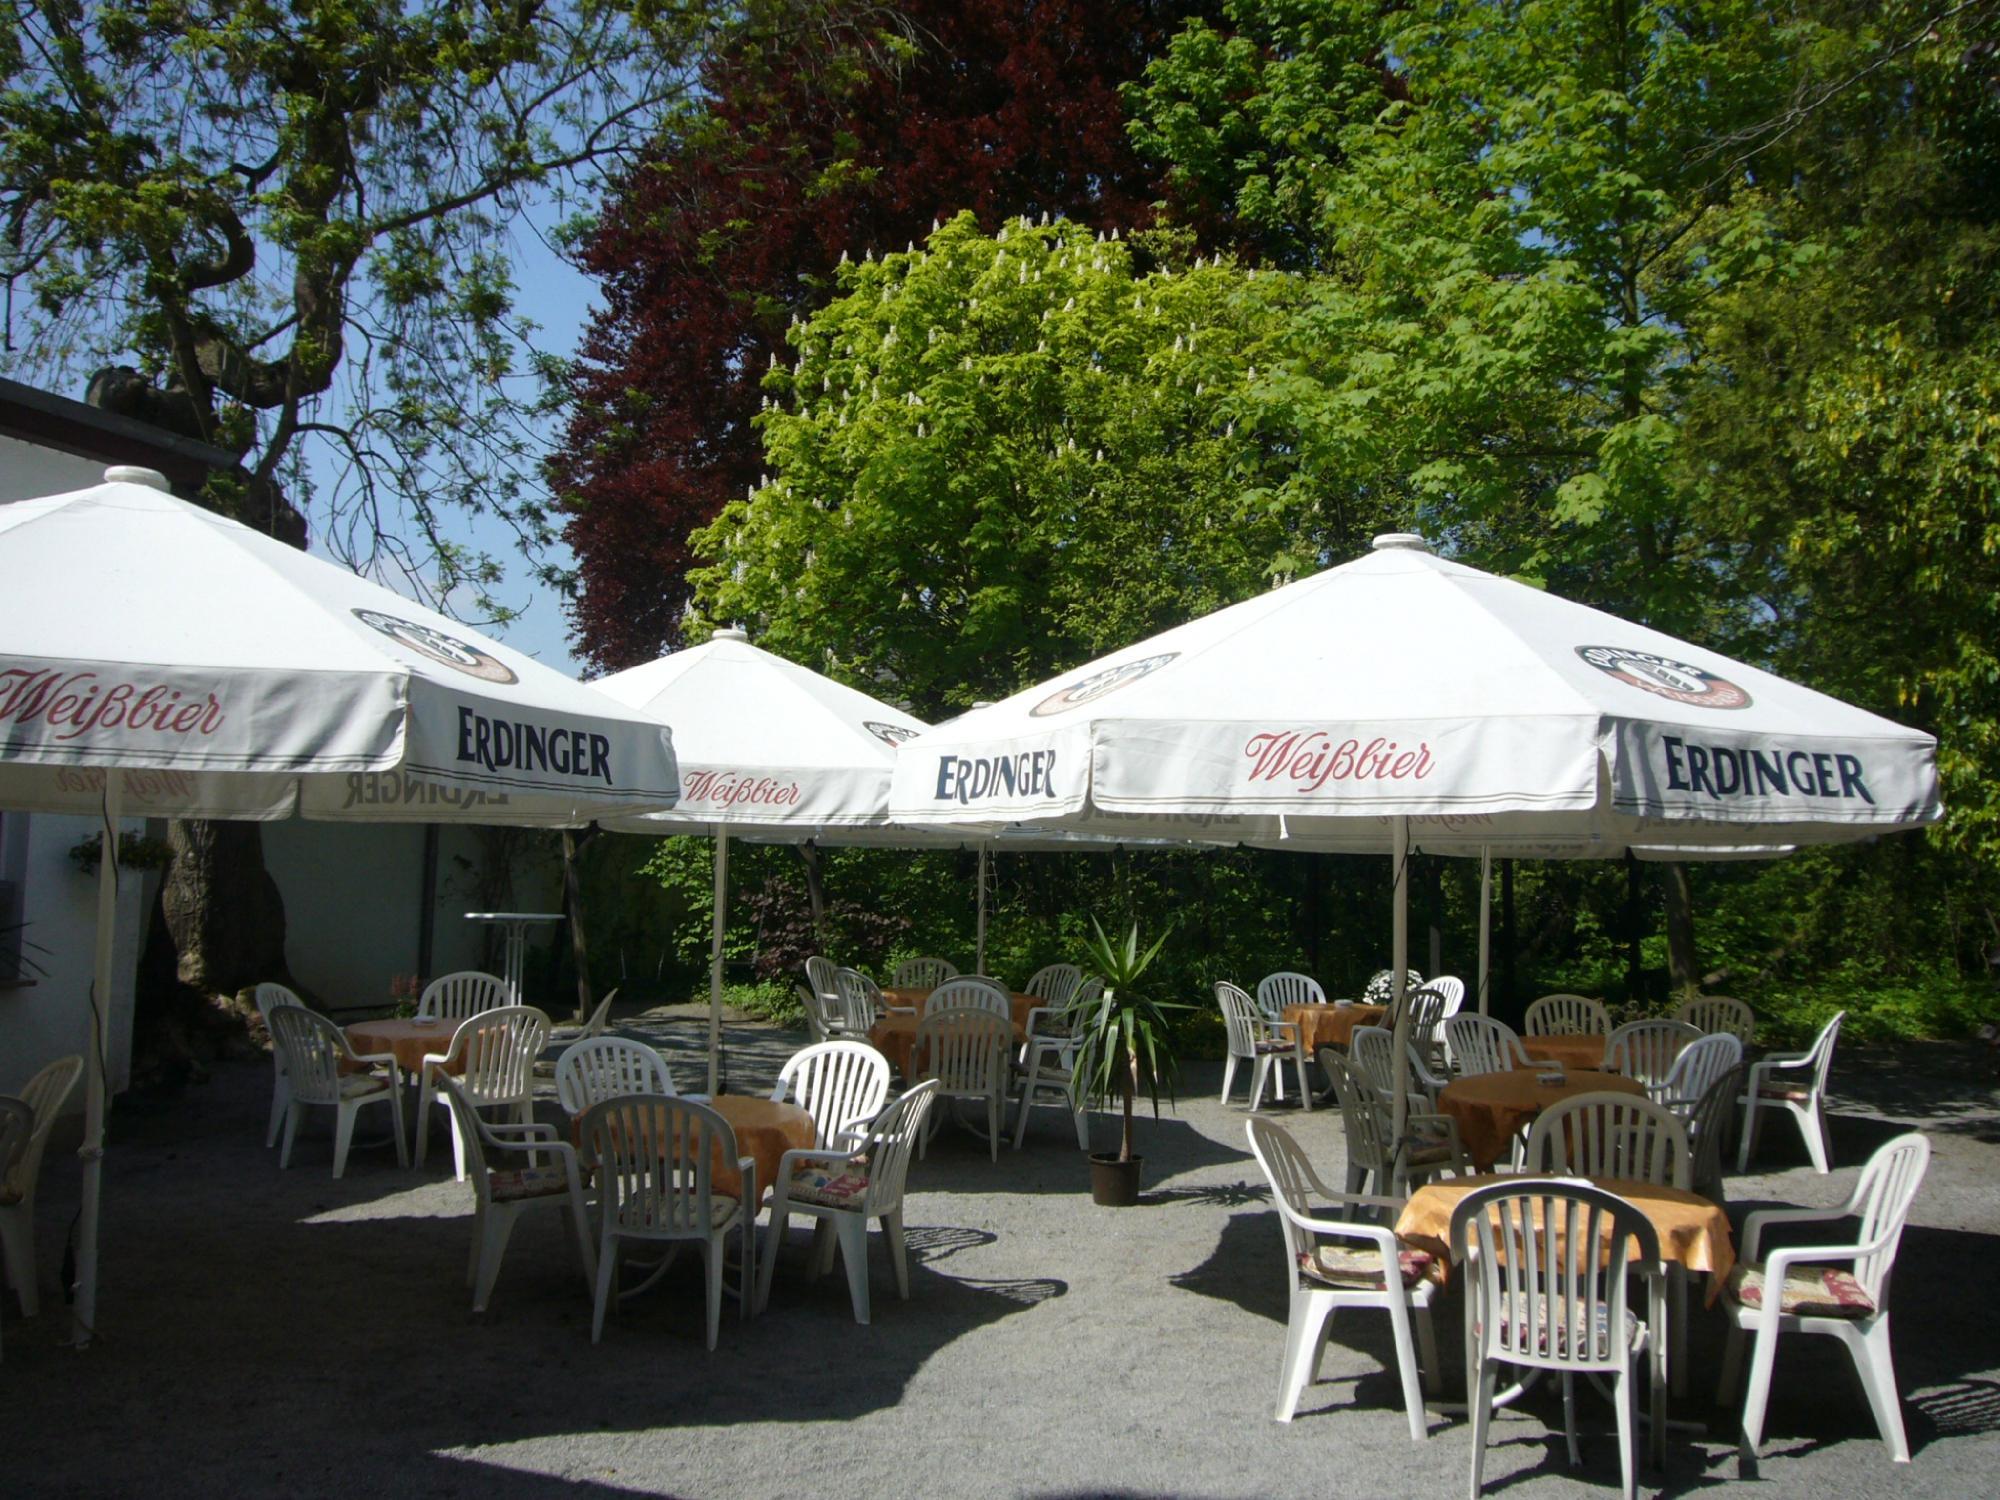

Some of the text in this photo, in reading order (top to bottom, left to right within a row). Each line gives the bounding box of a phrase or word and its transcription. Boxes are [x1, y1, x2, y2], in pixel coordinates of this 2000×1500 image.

[0, 668, 225, 740] Weißbier
[456, 705, 613, 785] ERDINGER
[934, 749, 1057, 805] ERDINGER
[1245, 731, 1436, 793] Weißbier
[1662, 736, 1876, 805] ERDINGER
[683, 770, 801, 809] Weißbier
